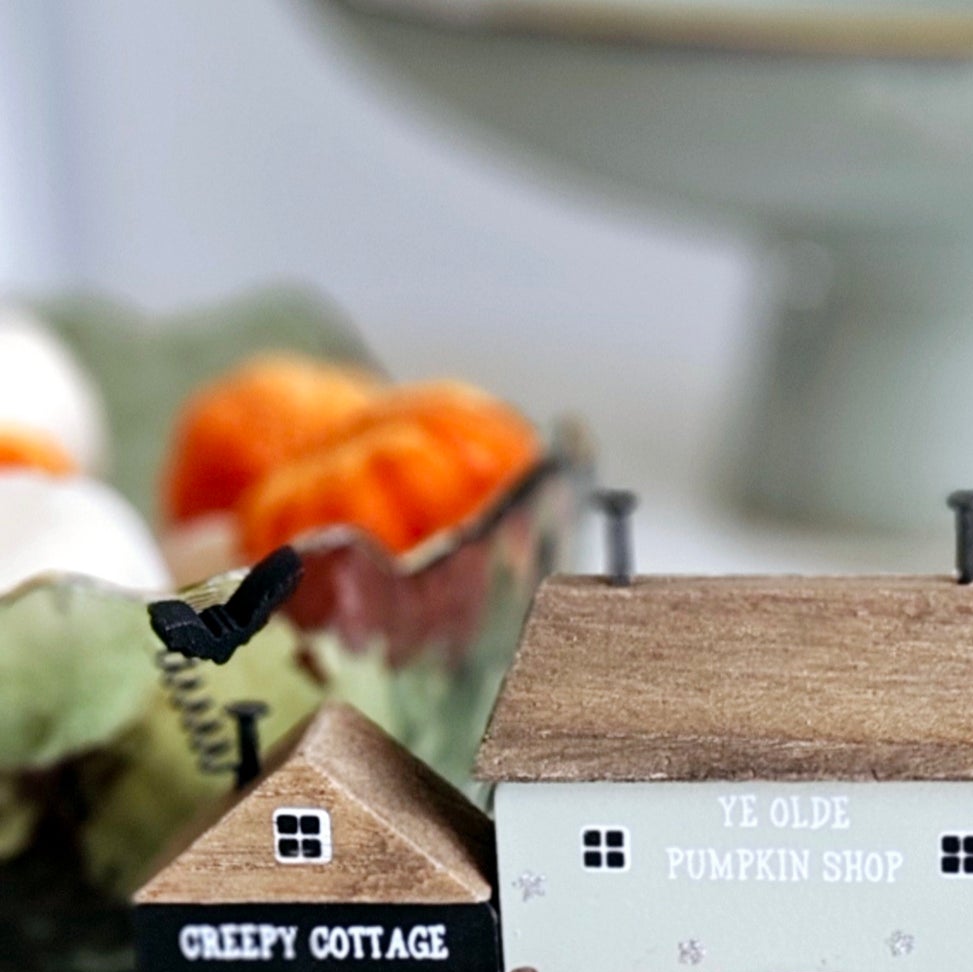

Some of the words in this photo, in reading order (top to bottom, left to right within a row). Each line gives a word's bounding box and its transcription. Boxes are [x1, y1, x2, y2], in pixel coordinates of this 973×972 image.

[718, 795, 759, 828] YE
[769, 795, 851, 831] OLDE
[665, 847, 811, 882] PUMPKIN
[822, 849, 904, 883] SHOP
[179, 923, 299, 961] CREEPY
[309, 924, 449, 961] COTTAGE
